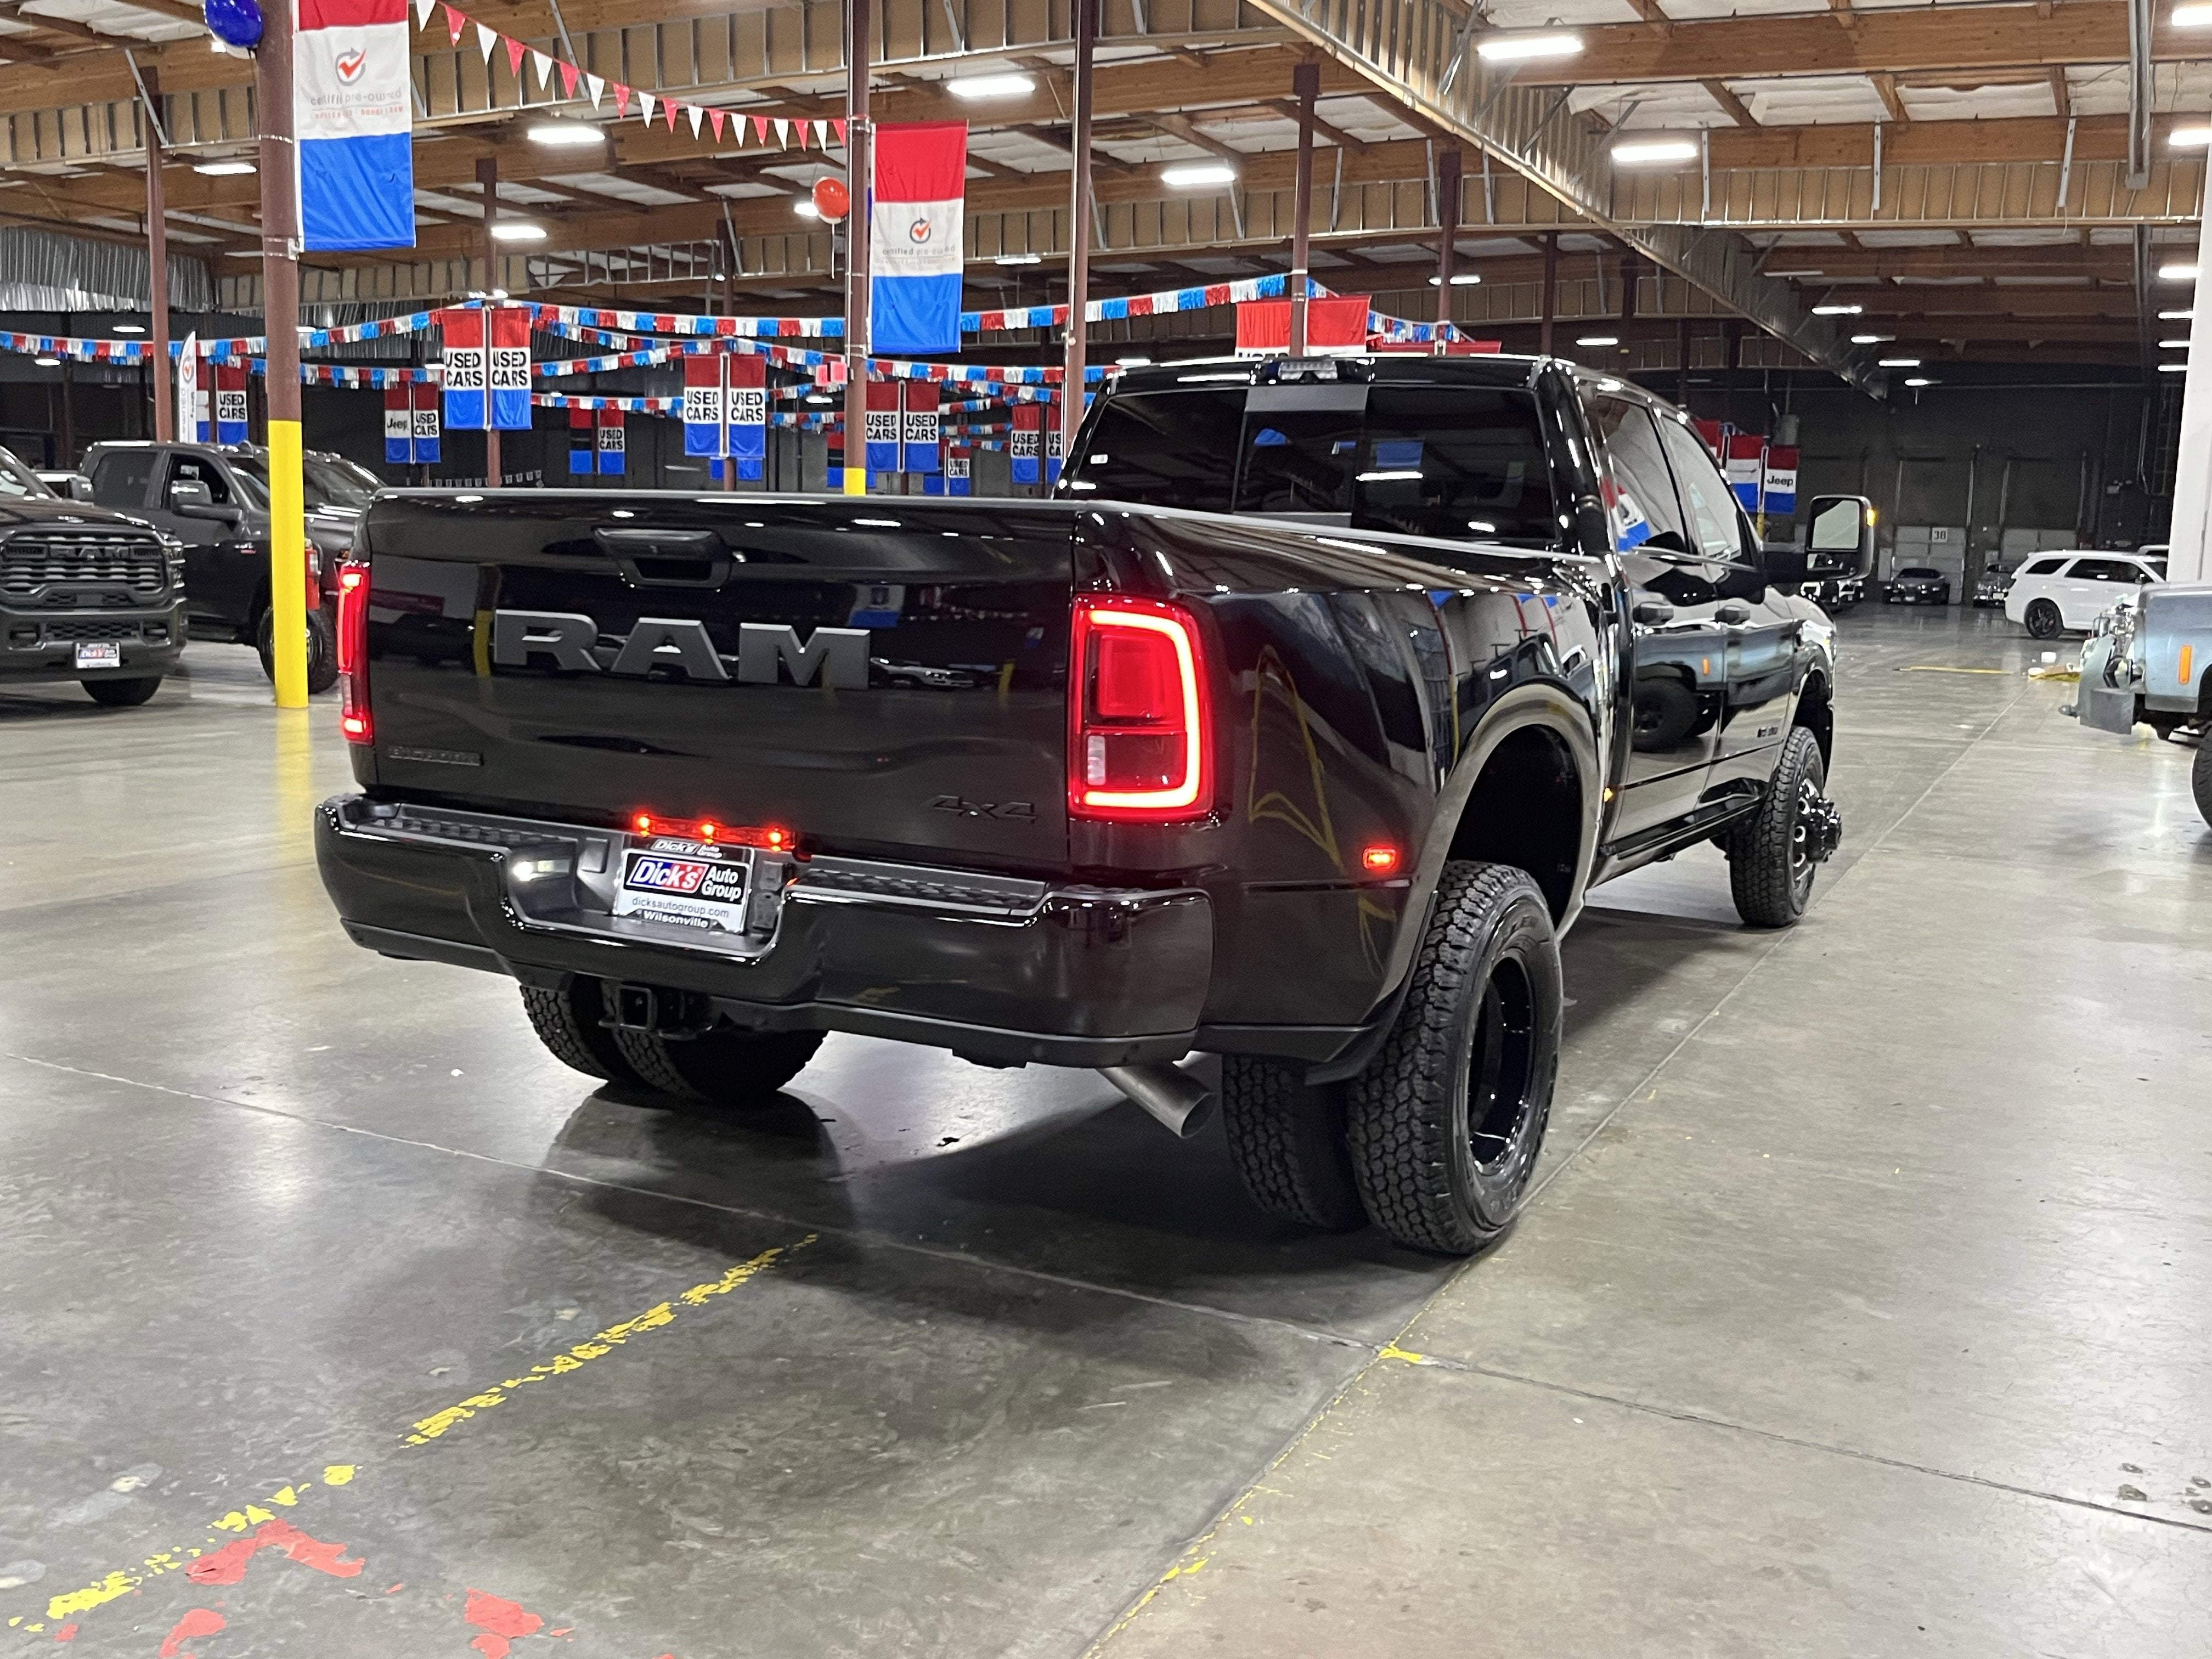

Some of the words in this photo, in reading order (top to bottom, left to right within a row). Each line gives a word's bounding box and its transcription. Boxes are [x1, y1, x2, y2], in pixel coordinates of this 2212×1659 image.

[916, 245, 955, 256] pre-owed
[445, 352, 481, 368] USED
[493, 351, 527, 367] USED
[447, 370, 483, 387] CARS
[492, 370, 528, 386] CARS
[219, 393, 245, 406] USED
[687, 391, 718, 405] USED
[731, 391, 763, 405] USED
[416, 413, 436, 424] USED
[687, 407, 719, 420] CARS
[731, 407, 763, 421] CARS
[866, 414, 896, 426] USED
[906, 414, 936, 427] USED
[600, 430, 623, 439] USED
[866, 427, 896, 440] CARS
[906, 428, 936, 441] CARS
[1013, 433, 1039, 444] USED
[1049, 433, 1061, 444] US
[600, 441, 623, 450] CARS
[1013, 445, 1039, 456] CARS
[1048, 445, 1061, 457] CA
[1766, 476, 1794, 487] Jeep
[494, 609, 871, 690] RAM
[633, 860, 699, 893] Dick's
[705, 866, 739, 884] Auto
[701, 881, 742, 901] Group
[632, 896, 729, 918] dicksautogroup.com
[644, 910, 709, 928] Wilsonville
